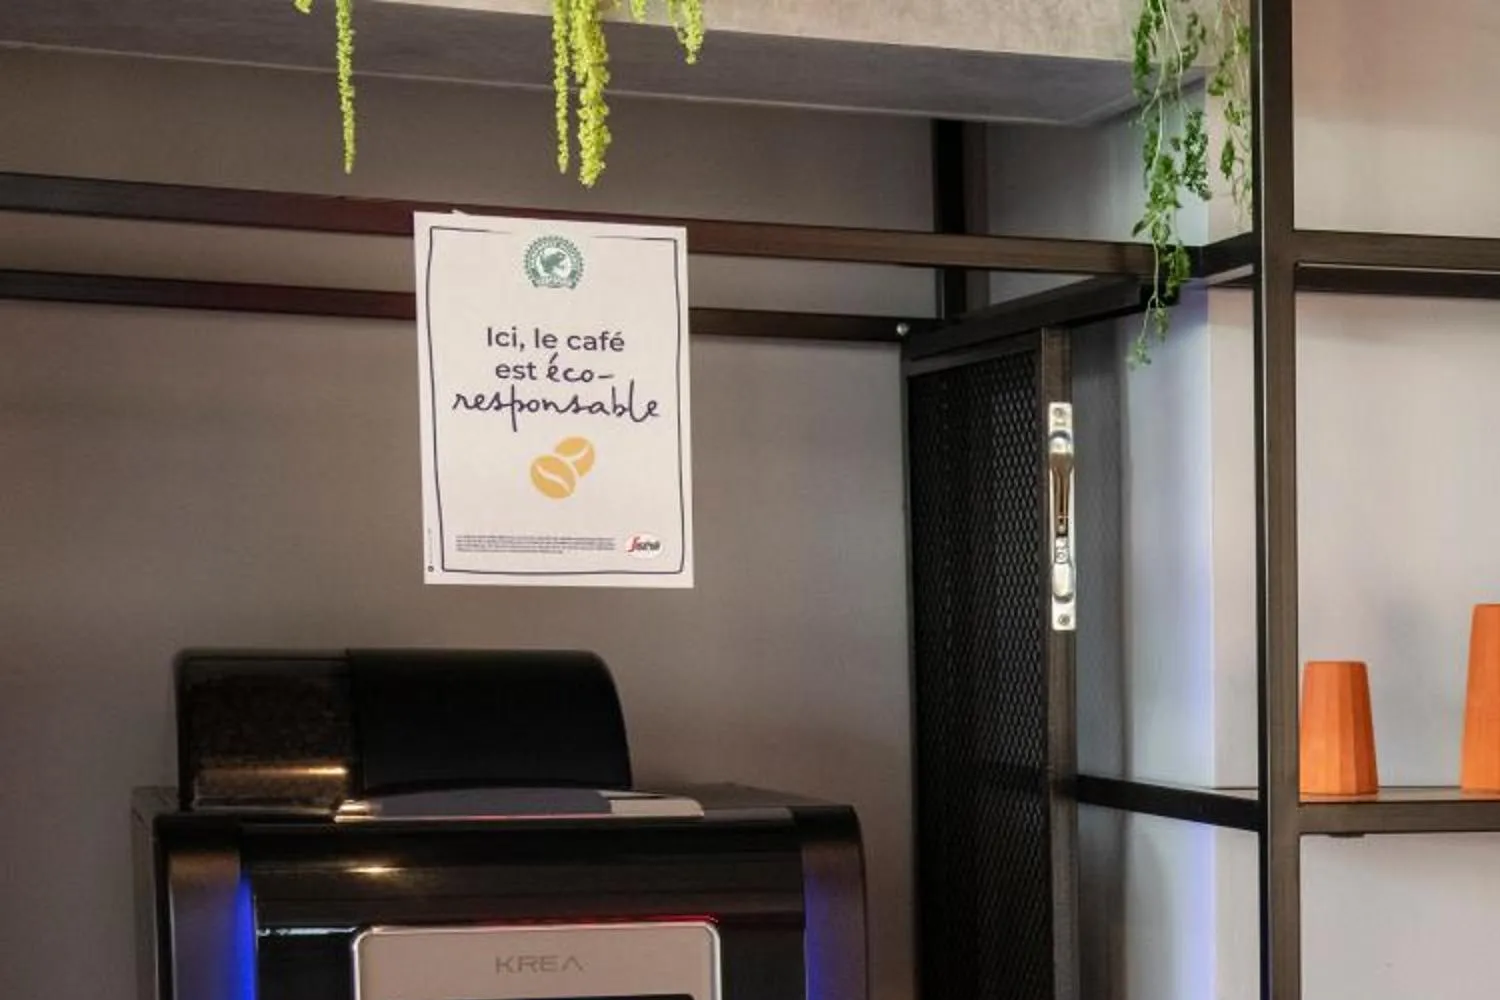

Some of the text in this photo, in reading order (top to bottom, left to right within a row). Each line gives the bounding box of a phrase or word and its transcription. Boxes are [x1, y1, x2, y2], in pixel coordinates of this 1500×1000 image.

[486, 326, 625, 352] Ici, le café
[495, 351, 615, 383] est éco-
[452, 379, 661, 432] responsable
[495, 954, 584, 975] KREA
